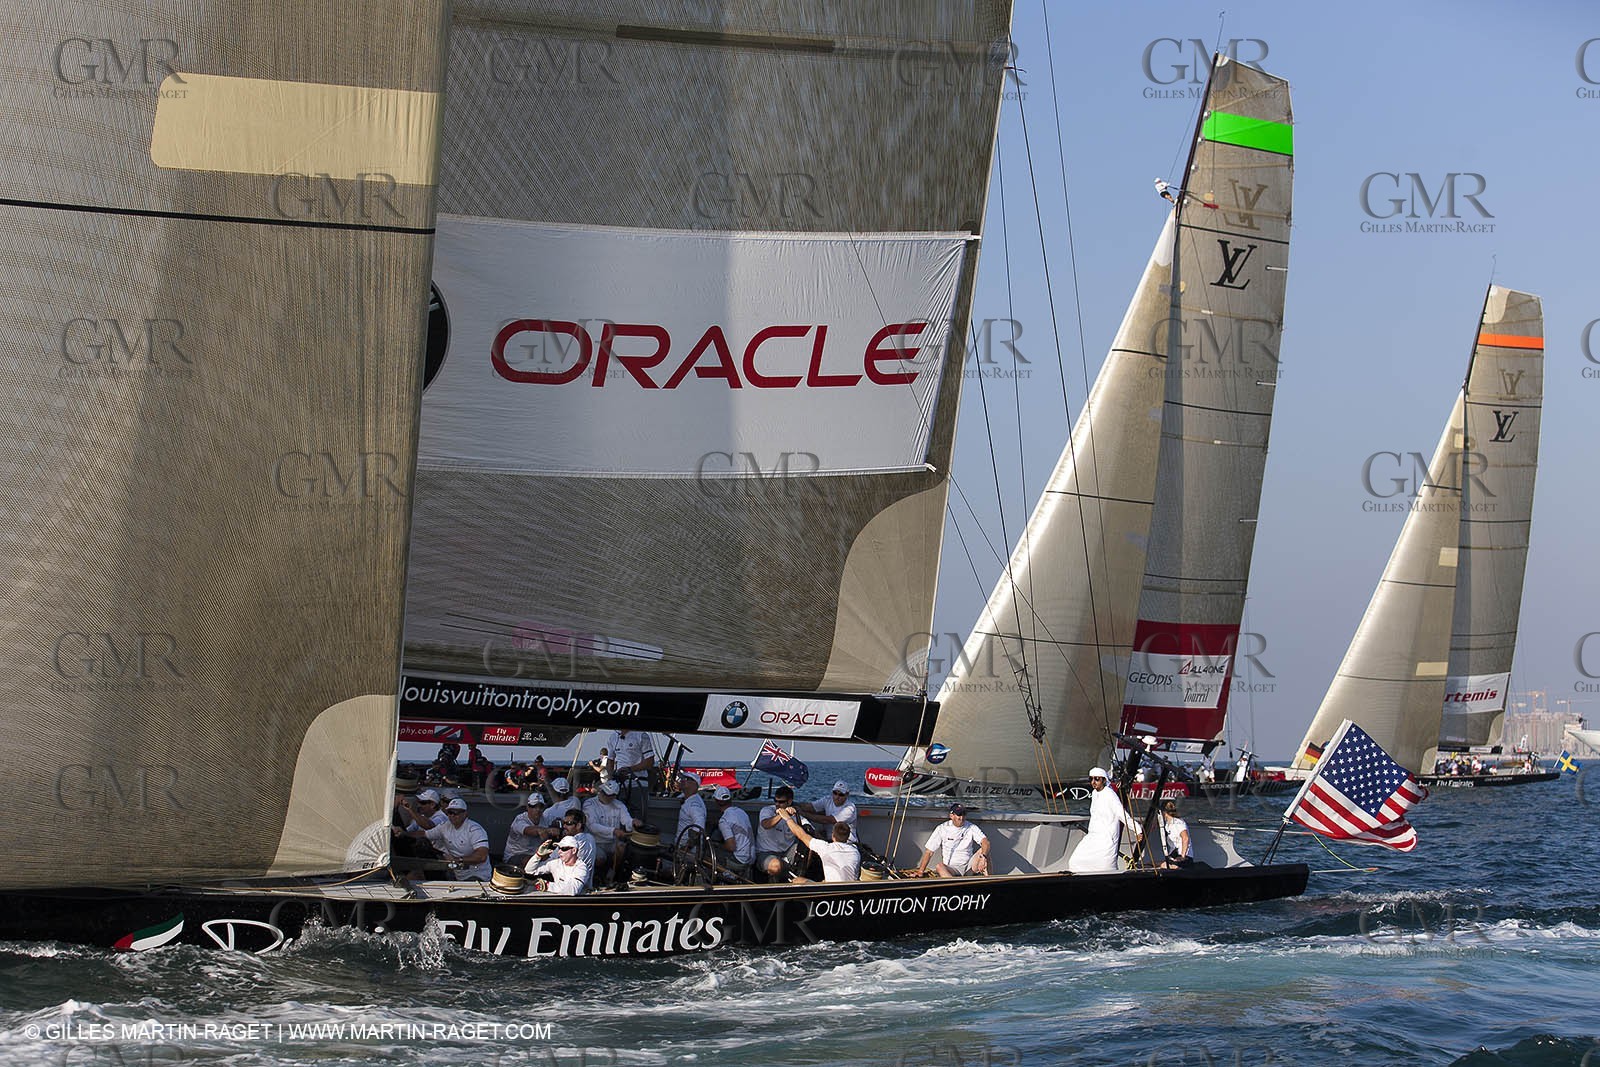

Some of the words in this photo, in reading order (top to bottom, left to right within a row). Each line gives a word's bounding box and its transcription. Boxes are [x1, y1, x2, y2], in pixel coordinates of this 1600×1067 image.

[491, 319, 929, 389] ORACLE
[1129, 672, 1174, 685] GEODIS
[401, 676, 640, 718] louisvuittontrophy.com
[1444, 688, 1498, 703] rtemis
[760, 711, 838, 726] ORACLE
[484, 734, 516, 742] Emirates
[965, 785, 990, 794] NEW
[990, 786, 1034, 796] ZEALAND
[808, 899, 855, 917] LOUIS
[859, 897, 927, 915] VUITTON
[931, 894, 991, 912] TROPHY
[527, 911, 724, 957] Emirates
